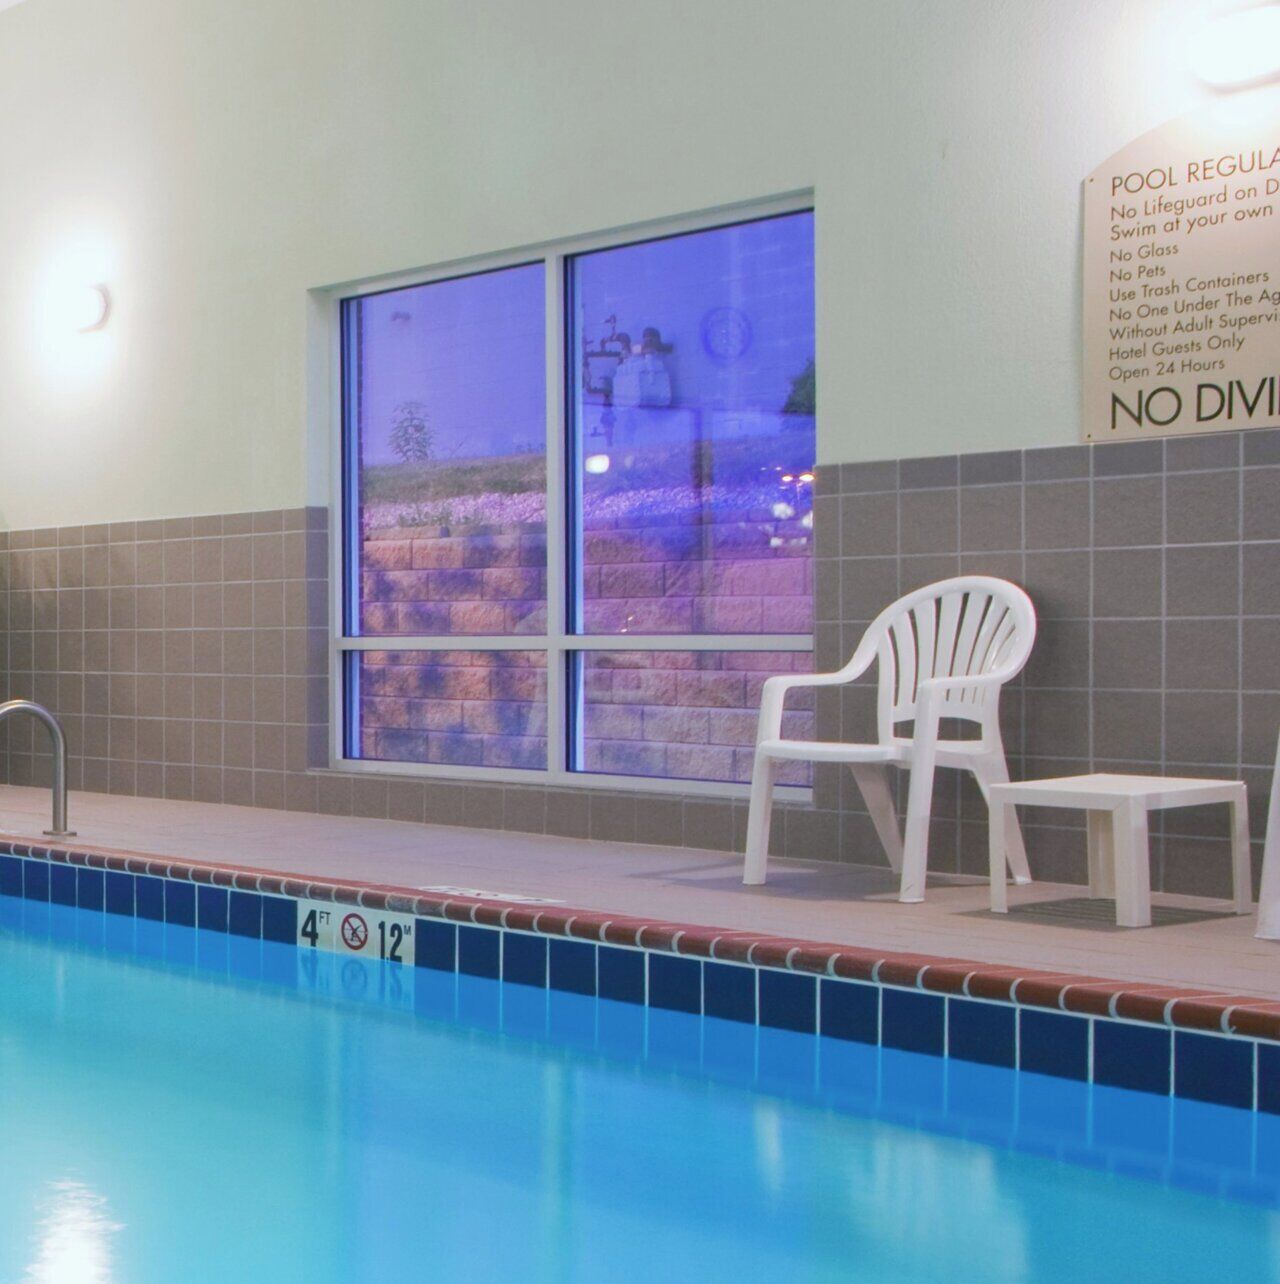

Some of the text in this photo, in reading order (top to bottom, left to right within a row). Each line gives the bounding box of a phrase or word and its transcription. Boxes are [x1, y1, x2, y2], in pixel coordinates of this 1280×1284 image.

[1111, 167, 1178, 196] POOL
[1111, 204, 1136, 220] No
[1144, 185, 1227, 215] Lifeguard
[1235, 187, 1256, 200] on
[1110, 205, 1272, 240] Swim at your own
[1110, 243, 1179, 263] No Glass
[1110, 265, 1166, 282] No Pets
[1110, 272, 1269, 302] Use Trash Containers
[1110, 308, 1131, 322] No
[1137, 304, 1168, 318] One
[1175, 295, 1219, 313] Under
[1226, 291, 1252, 306] The
[1110, 308, 1280, 340] Without Adult Supervi
[1109, 333, 1245, 360] Hotel Guests Only
[1109, 359, 1225, 382] Open 24 Hours
[1111, 376, 1280, 429] NO DIVI
[301, 910, 331, 946] 4 FT
